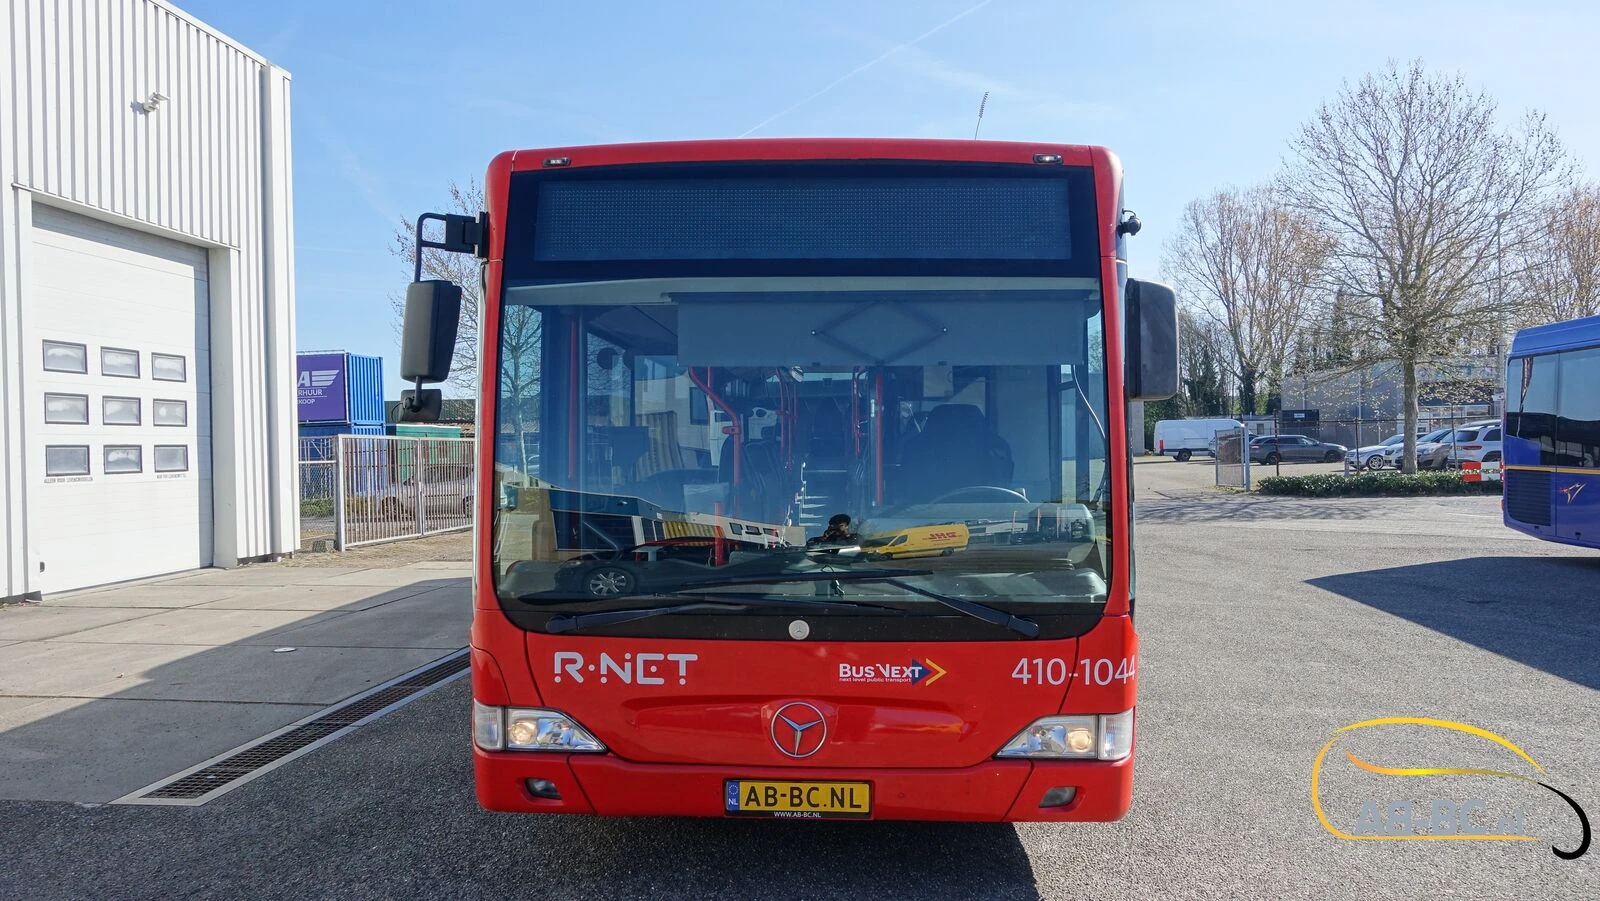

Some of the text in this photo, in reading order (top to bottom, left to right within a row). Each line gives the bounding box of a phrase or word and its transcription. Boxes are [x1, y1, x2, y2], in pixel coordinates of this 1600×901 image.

[1011, 655, 1136, 686] 410-1044
[728, 785, 862, 809] NL AB-BC.NL
